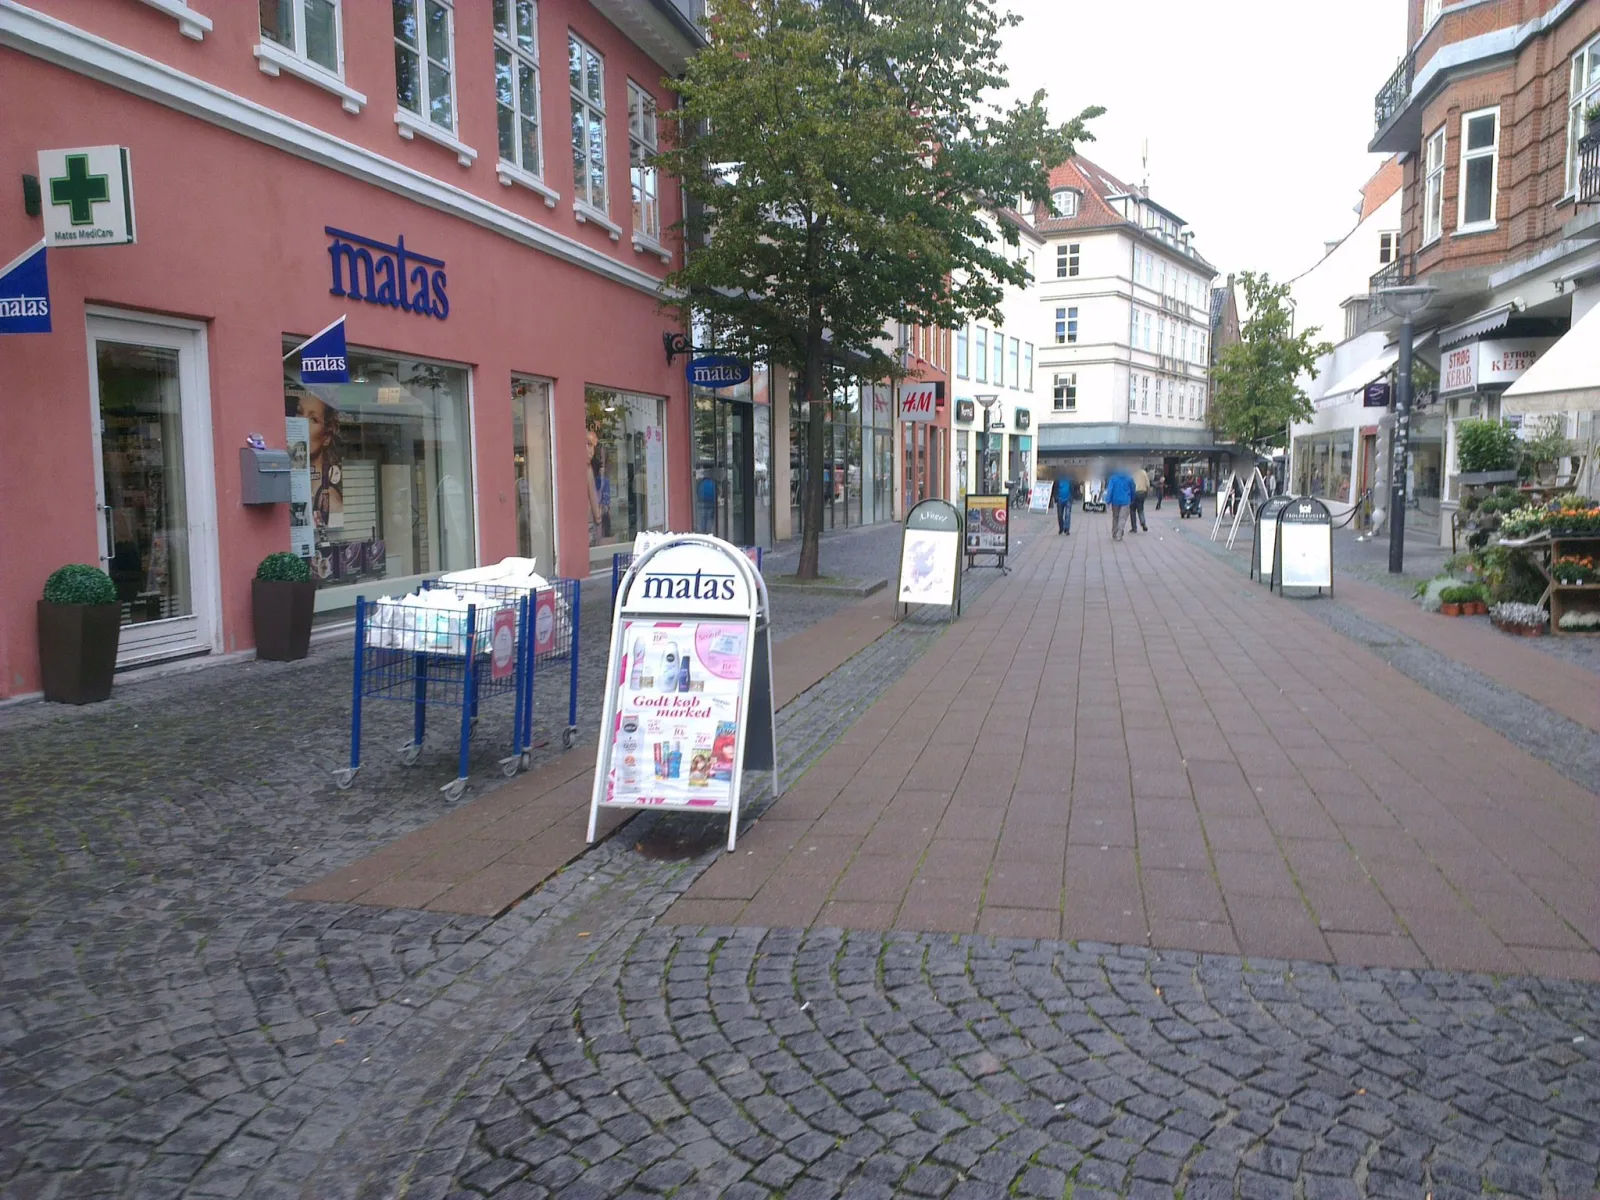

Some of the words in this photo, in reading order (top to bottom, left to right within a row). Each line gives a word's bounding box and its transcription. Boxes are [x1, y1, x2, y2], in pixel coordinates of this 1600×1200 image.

[54, 231, 77, 240] Matas
[78, 228, 114, 239] MediCare
[324, 226, 449, 320] matas
[301, 354, 346, 372] matas
[1449, 348, 1470, 369] STRØG
[1503, 350, 1536, 359] STRØG
[693, 364, 742, 382] matas
[1445, 366, 1472, 389] KEBAB
[902, 391, 932, 413] H&M
[642, 568, 735, 600] matas
[633, 695, 668, 706] Godt
[672, 695, 700, 707] køb
[656, 707, 711, 718] marked
